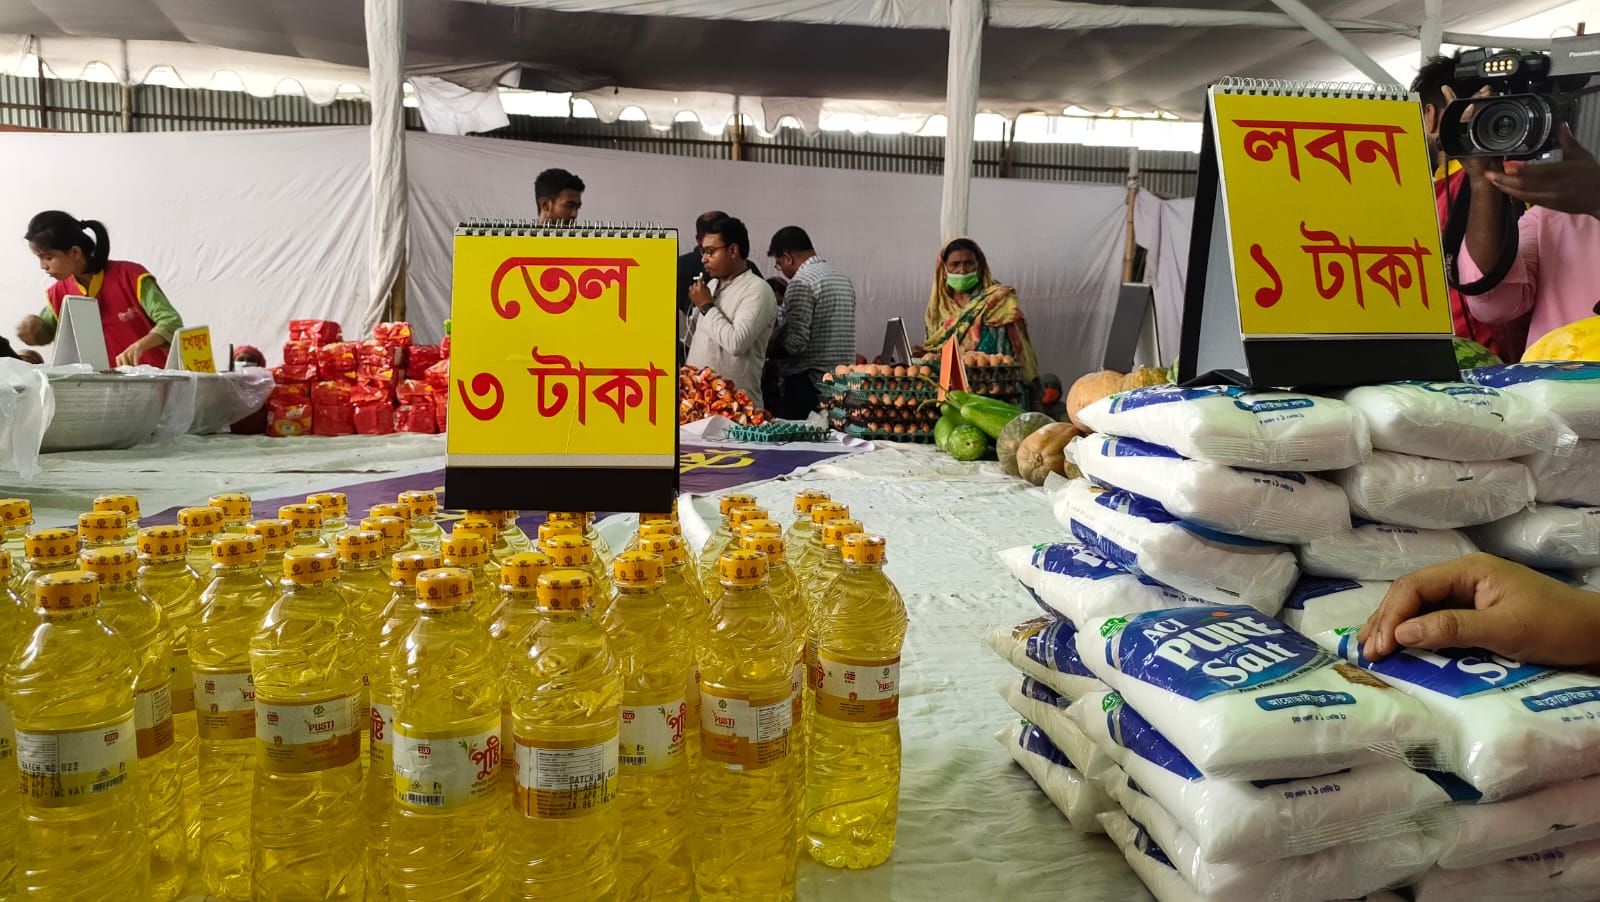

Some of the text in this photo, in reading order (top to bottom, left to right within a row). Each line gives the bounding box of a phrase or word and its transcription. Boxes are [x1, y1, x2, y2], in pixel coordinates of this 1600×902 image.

[1231, 119, 1408, 187] লবন
[490, 256, 641, 324] তেল
[1250, 220, 1433, 310] ১ টাকা
[457, 346, 669, 426] ৩ টাকা
[1142, 618, 1189, 645] ACI
[1157, 616, 1286, 671] PURE
[1202, 641, 1300, 687] Salt
[308, 720, 335, 732] PUSTI
[714, 715, 735, 726] PUSTI
